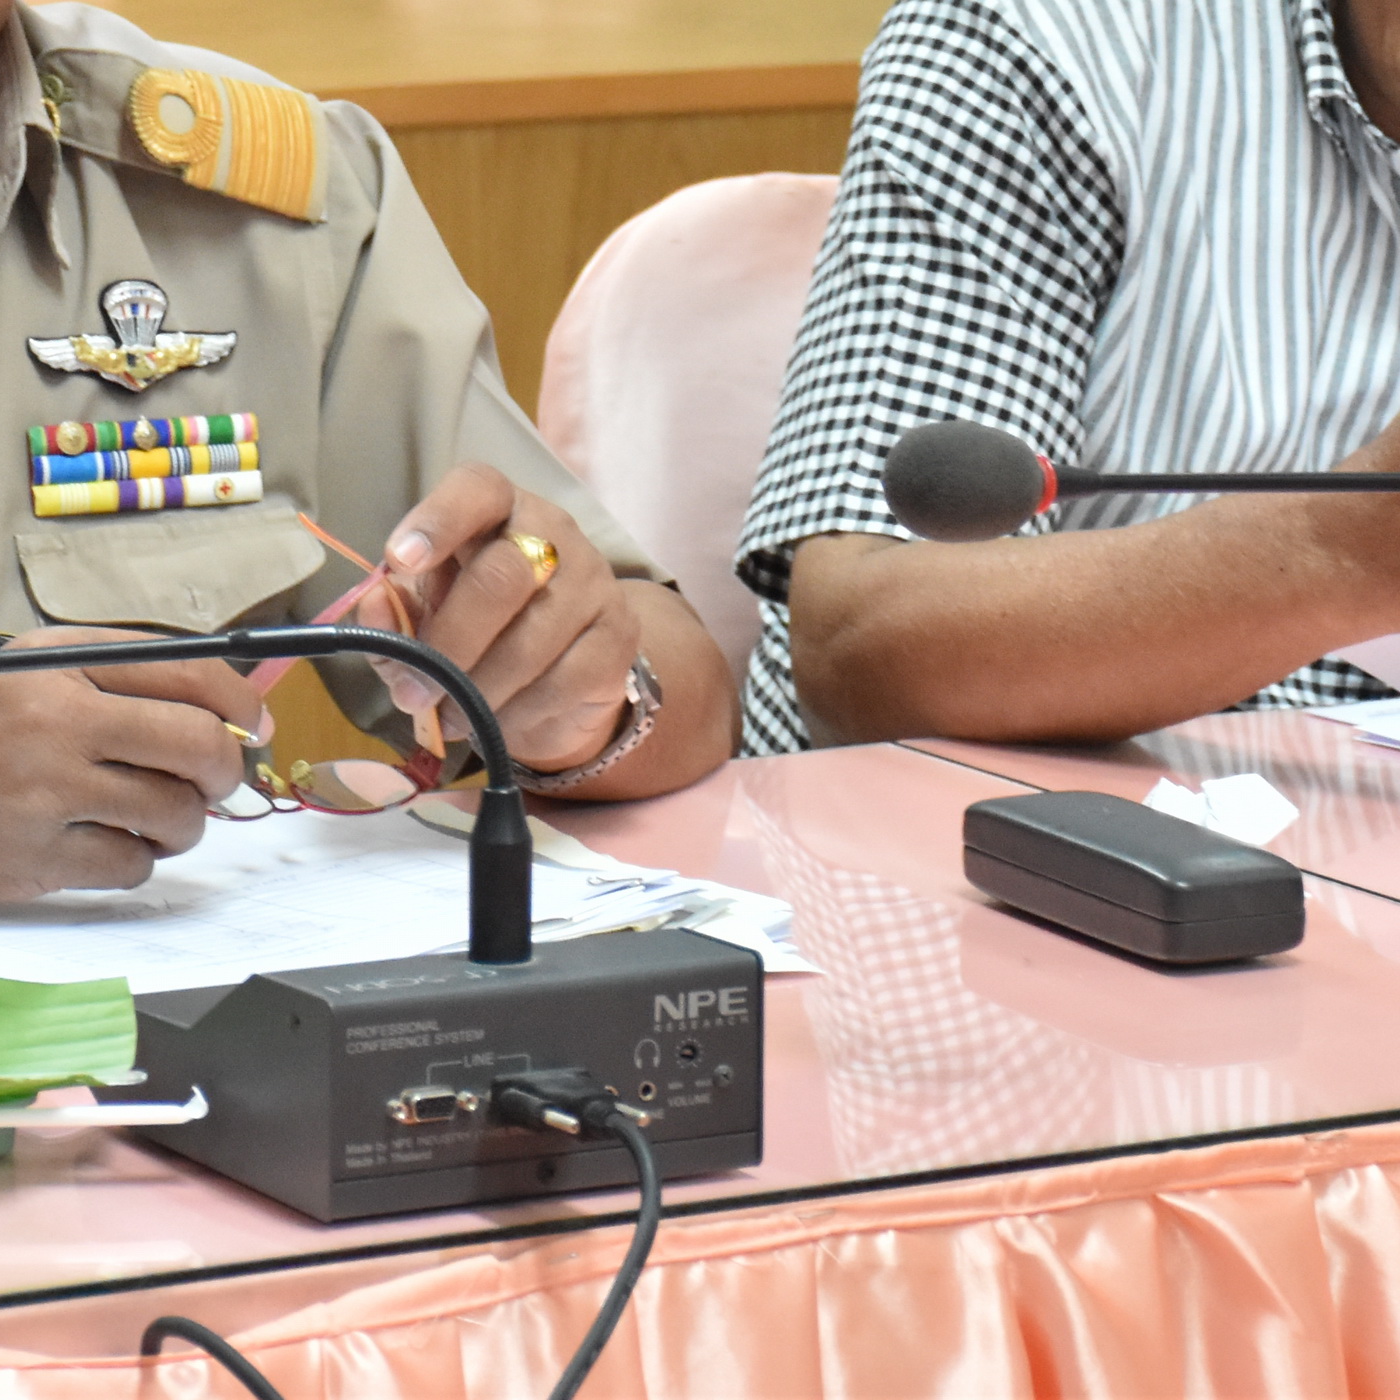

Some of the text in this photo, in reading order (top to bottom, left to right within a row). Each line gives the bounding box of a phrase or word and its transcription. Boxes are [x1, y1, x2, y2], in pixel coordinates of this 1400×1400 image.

[653, 986, 749, 1022] NPE
[346, 1020, 440, 1040] PROFESSIONAL
[346, 1028, 486, 1055] CONFERENCE SYSTEM
[463, 1052, 495, 1068] LINE
